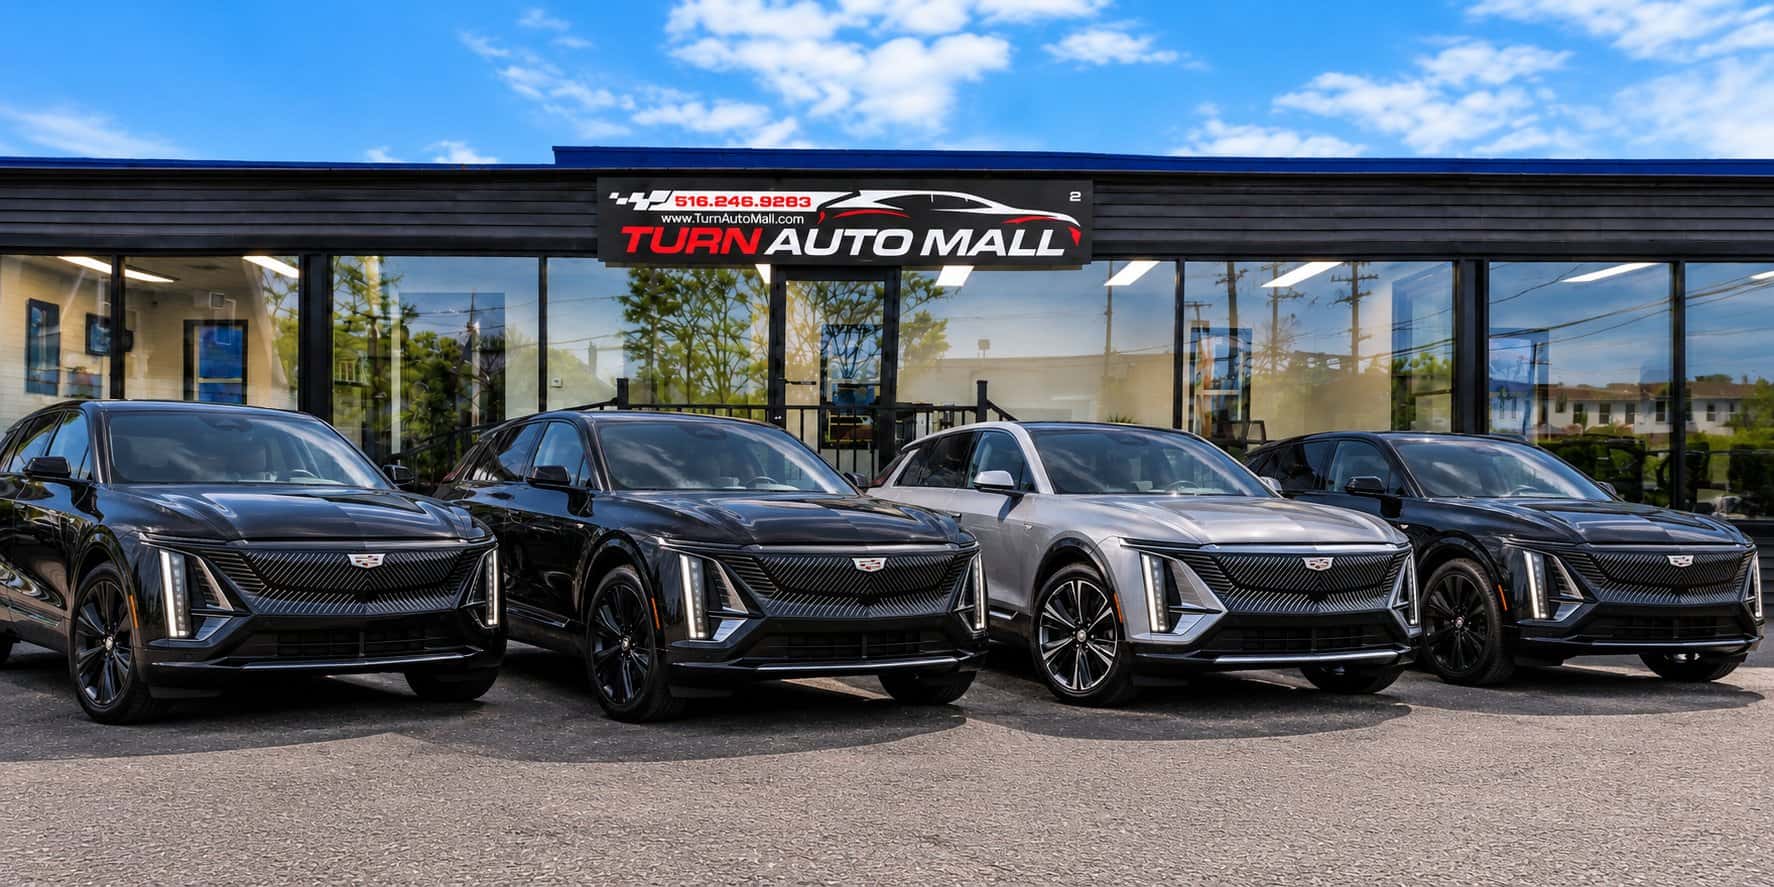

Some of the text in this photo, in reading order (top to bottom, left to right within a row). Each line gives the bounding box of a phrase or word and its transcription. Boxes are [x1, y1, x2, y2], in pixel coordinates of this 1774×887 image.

[675, 195, 811, 208] 516.246.9283
[1070, 191, 1082, 202] 2
[661, 212, 805, 225] www.TurnAutoMall.com
[621, 226, 1066, 257] TURN AUTO MALL
